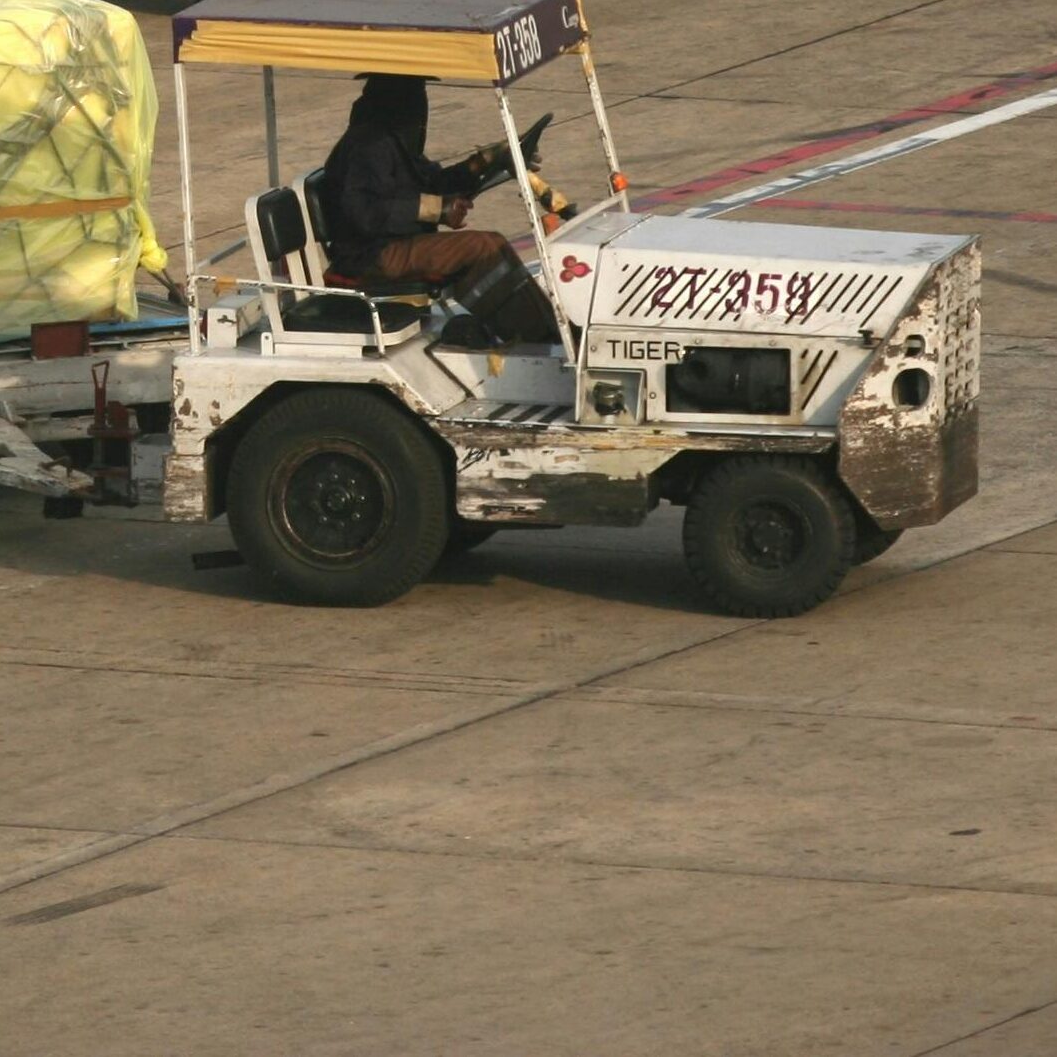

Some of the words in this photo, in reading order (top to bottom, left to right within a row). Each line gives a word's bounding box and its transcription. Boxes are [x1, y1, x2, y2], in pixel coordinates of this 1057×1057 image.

[496, 14, 542, 78] 2T-358
[650, 265, 813, 318] 2T-358
[606, 339, 681, 361] TIGER
